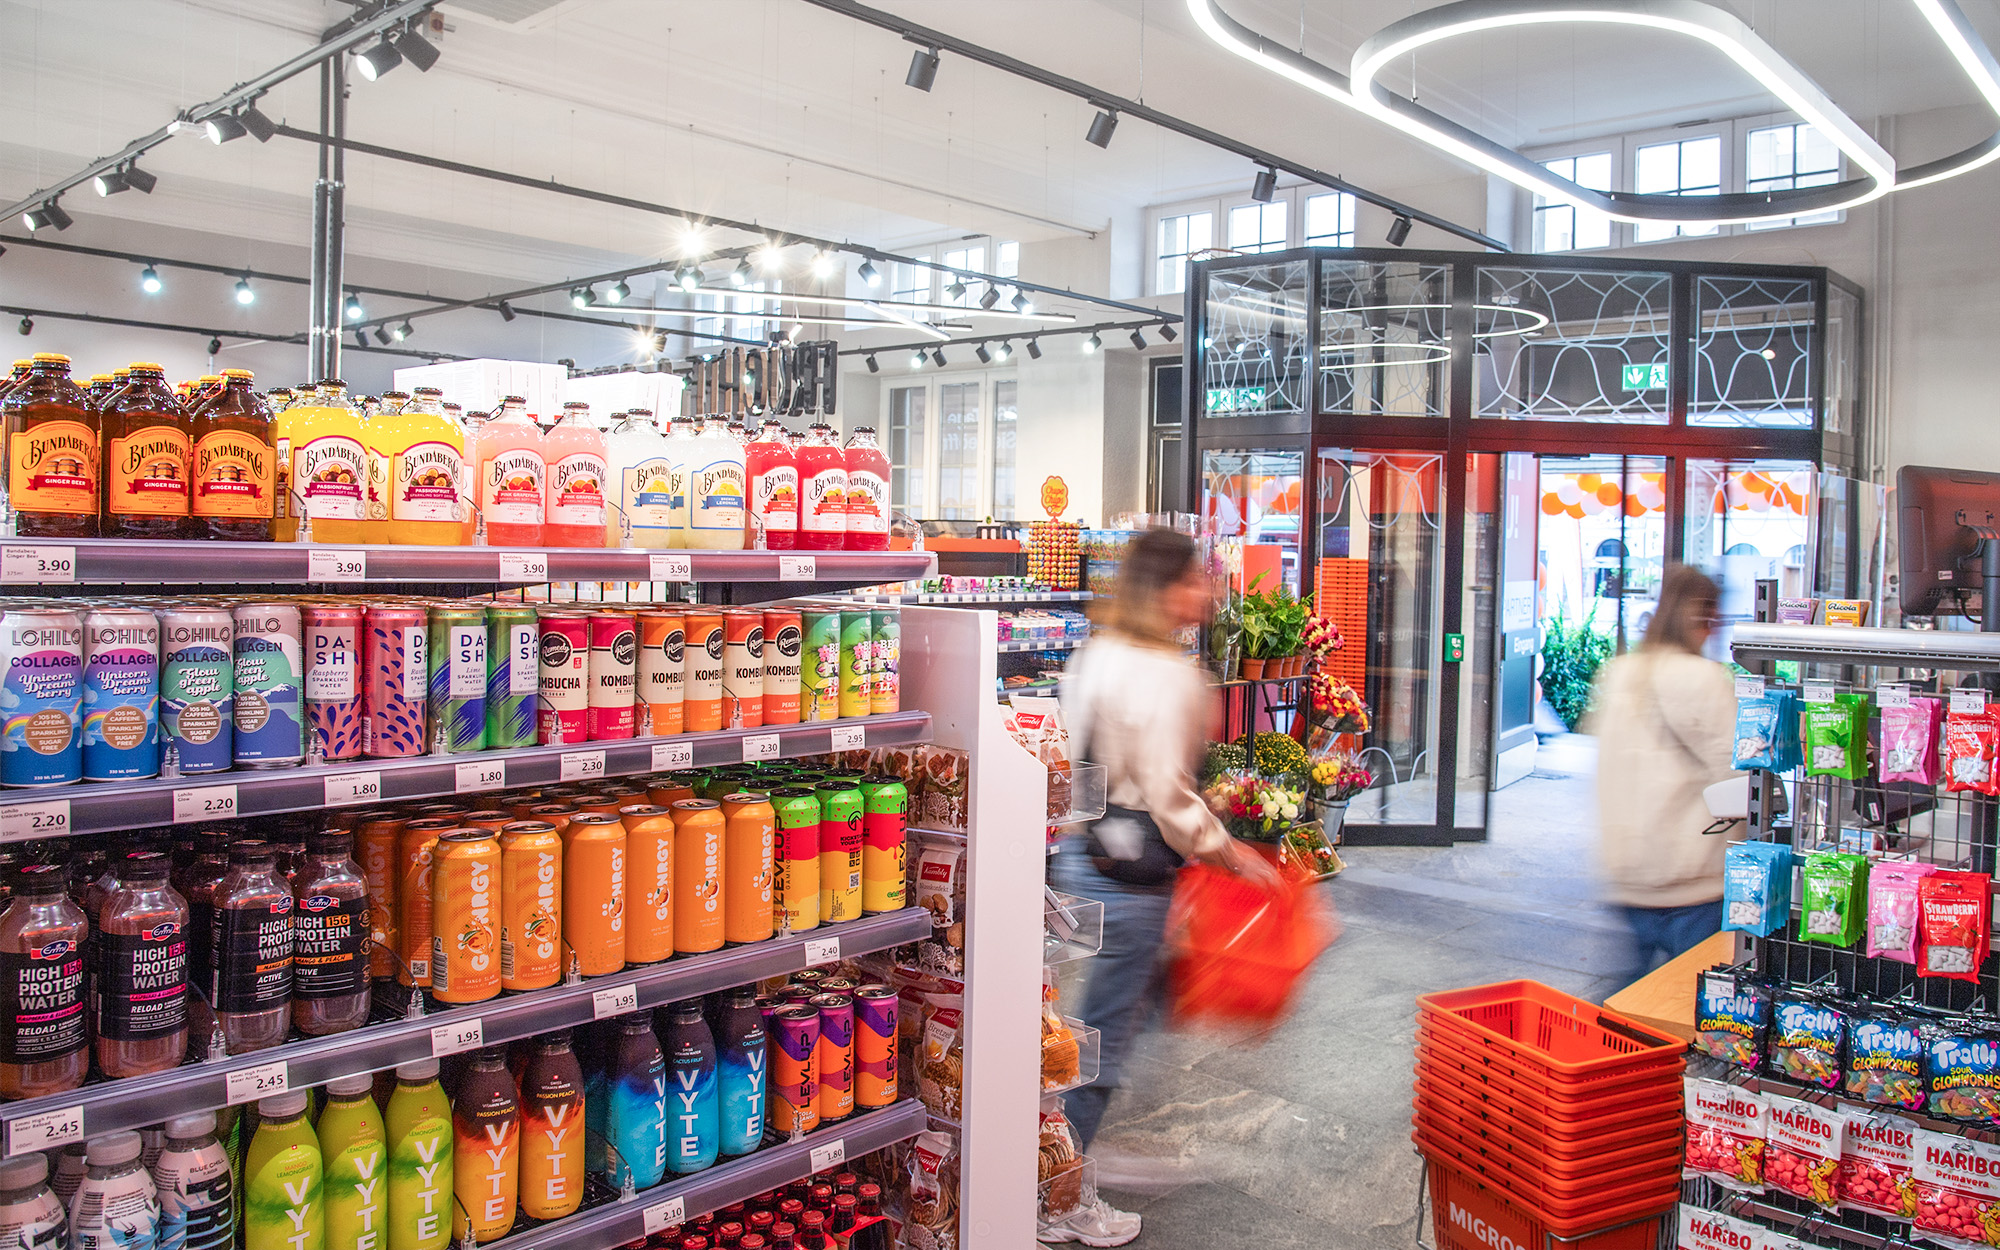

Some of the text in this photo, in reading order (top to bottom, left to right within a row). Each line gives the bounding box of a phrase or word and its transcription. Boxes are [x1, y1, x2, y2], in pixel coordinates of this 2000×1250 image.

[22, 434, 96, 475] BUNDABERG
[196, 442, 268, 480] BUNDABERG
[300, 444, 367, 482] BUNDABERG
[44, 478, 71, 486] GINGER
[143, 481, 168, 489] GINGER
[210, 484, 232, 492] GINGER
[37, 559, 71, 572] 3.90
[336, 562, 362, 573] 3.90
[523, 564, 545, 573] 3.90
[669, 565, 689, 574] 3.90
[797, 565, 814, 574] 3.90
[1779, 600, 1808, 609] Ricola
[1827, 602, 1857, 611] Ricola
[11, 629, 81, 647] LOHILO
[91, 628, 157, 644] LOHILO
[315, 635, 351, 648] DA-
[1513, 636, 1535, 655] Eingang
[11, 655, 82, 668] COLLAGEN
[90, 653, 157, 665] COLLAGEN
[315, 651, 345, 665] SH
[461, 650, 484, 663] SH
[18, 672, 74, 685] Unicorn
[96, 671, 149, 683] Unicorn
[178, 668, 220, 680] Glow
[237, 674, 270, 685] apple
[312, 669, 348, 678] Raspberry
[24, 680, 77, 695] Dreams
[102, 677, 152, 691] Dreams
[179, 677, 217, 689] green
[36, 687, 72, 699] berry
[113, 686, 148, 695] berry
[186, 684, 222, 696] apple
[38, 738, 63, 746] SUGAR
[847, 735, 863, 744] 2.95
[760, 744, 778, 752] 2.30
[671, 753, 691, 762] 2.30
[581, 761, 603, 772] 2.30
[479, 772, 502, 782] 1.80
[352, 784, 377, 796] 1.80
[204, 799, 233, 810] 2.20
[32, 815, 65, 828] 2.20
[1925, 902, 1978, 916] STRAWBERRY
[328, 915, 349, 926] 15G
[1928, 914, 1957, 922] FLAVOUR
[153, 926, 174, 937] Emmi
[259, 919, 288, 934] HIGH
[43, 942, 68, 955] Emmi
[133, 946, 167, 962] HIGH
[821, 946, 838, 957] 2.40
[132, 953, 186, 976] PROTEIN
[19, 966, 61, 982] HIGH
[132, 970, 180, 989] WATER
[256, 972, 283, 984] ACTIVE
[18, 972, 83, 996] PROTEIN
[1719, 986, 1733, 994] 1.70
[18, 989, 76, 1010] WATER
[614, 995, 635, 1007] 1.95
[130, 1003, 164, 1014] RELOAD
[1781, 1005, 1840, 1033] Trolli
[17, 1024, 57, 1036] RELOAD
[1700, 1018, 1754, 1039] GLOWWORMS
[456, 1029, 480, 1043] 1.95
[1856, 1024, 1920, 1052] Trolli
[1871, 1050, 1892, 1058] SOUR
[1931, 1041, 1998, 1069] Trolli
[800, 1030, 811, 1109] LEVLUP
[1852, 1057, 1919, 1076] GLOWWORMS
[256, 1074, 284, 1089] 2.45
[536, 1089, 576, 1099] PASSION PEACH
[476, 1109, 500, 1118] PASSION
[1702, 1112, 1747, 1129] primavera
[1772, 1107, 1832, 1139] HARIBO
[46, 1121, 79, 1137] 2.45
[1779, 1128, 1821, 1149] primavera
[827, 1149, 843, 1161] 1.80
[189, 1157, 225, 1174] BLUE CHILL
[276, 1164, 315, 1178] LEMONGRASS
[414, 1136, 440, 1242] VYTE
[35, 1211, 51, 1223] BLUE
[663, 1207, 683, 1221] 2.10
